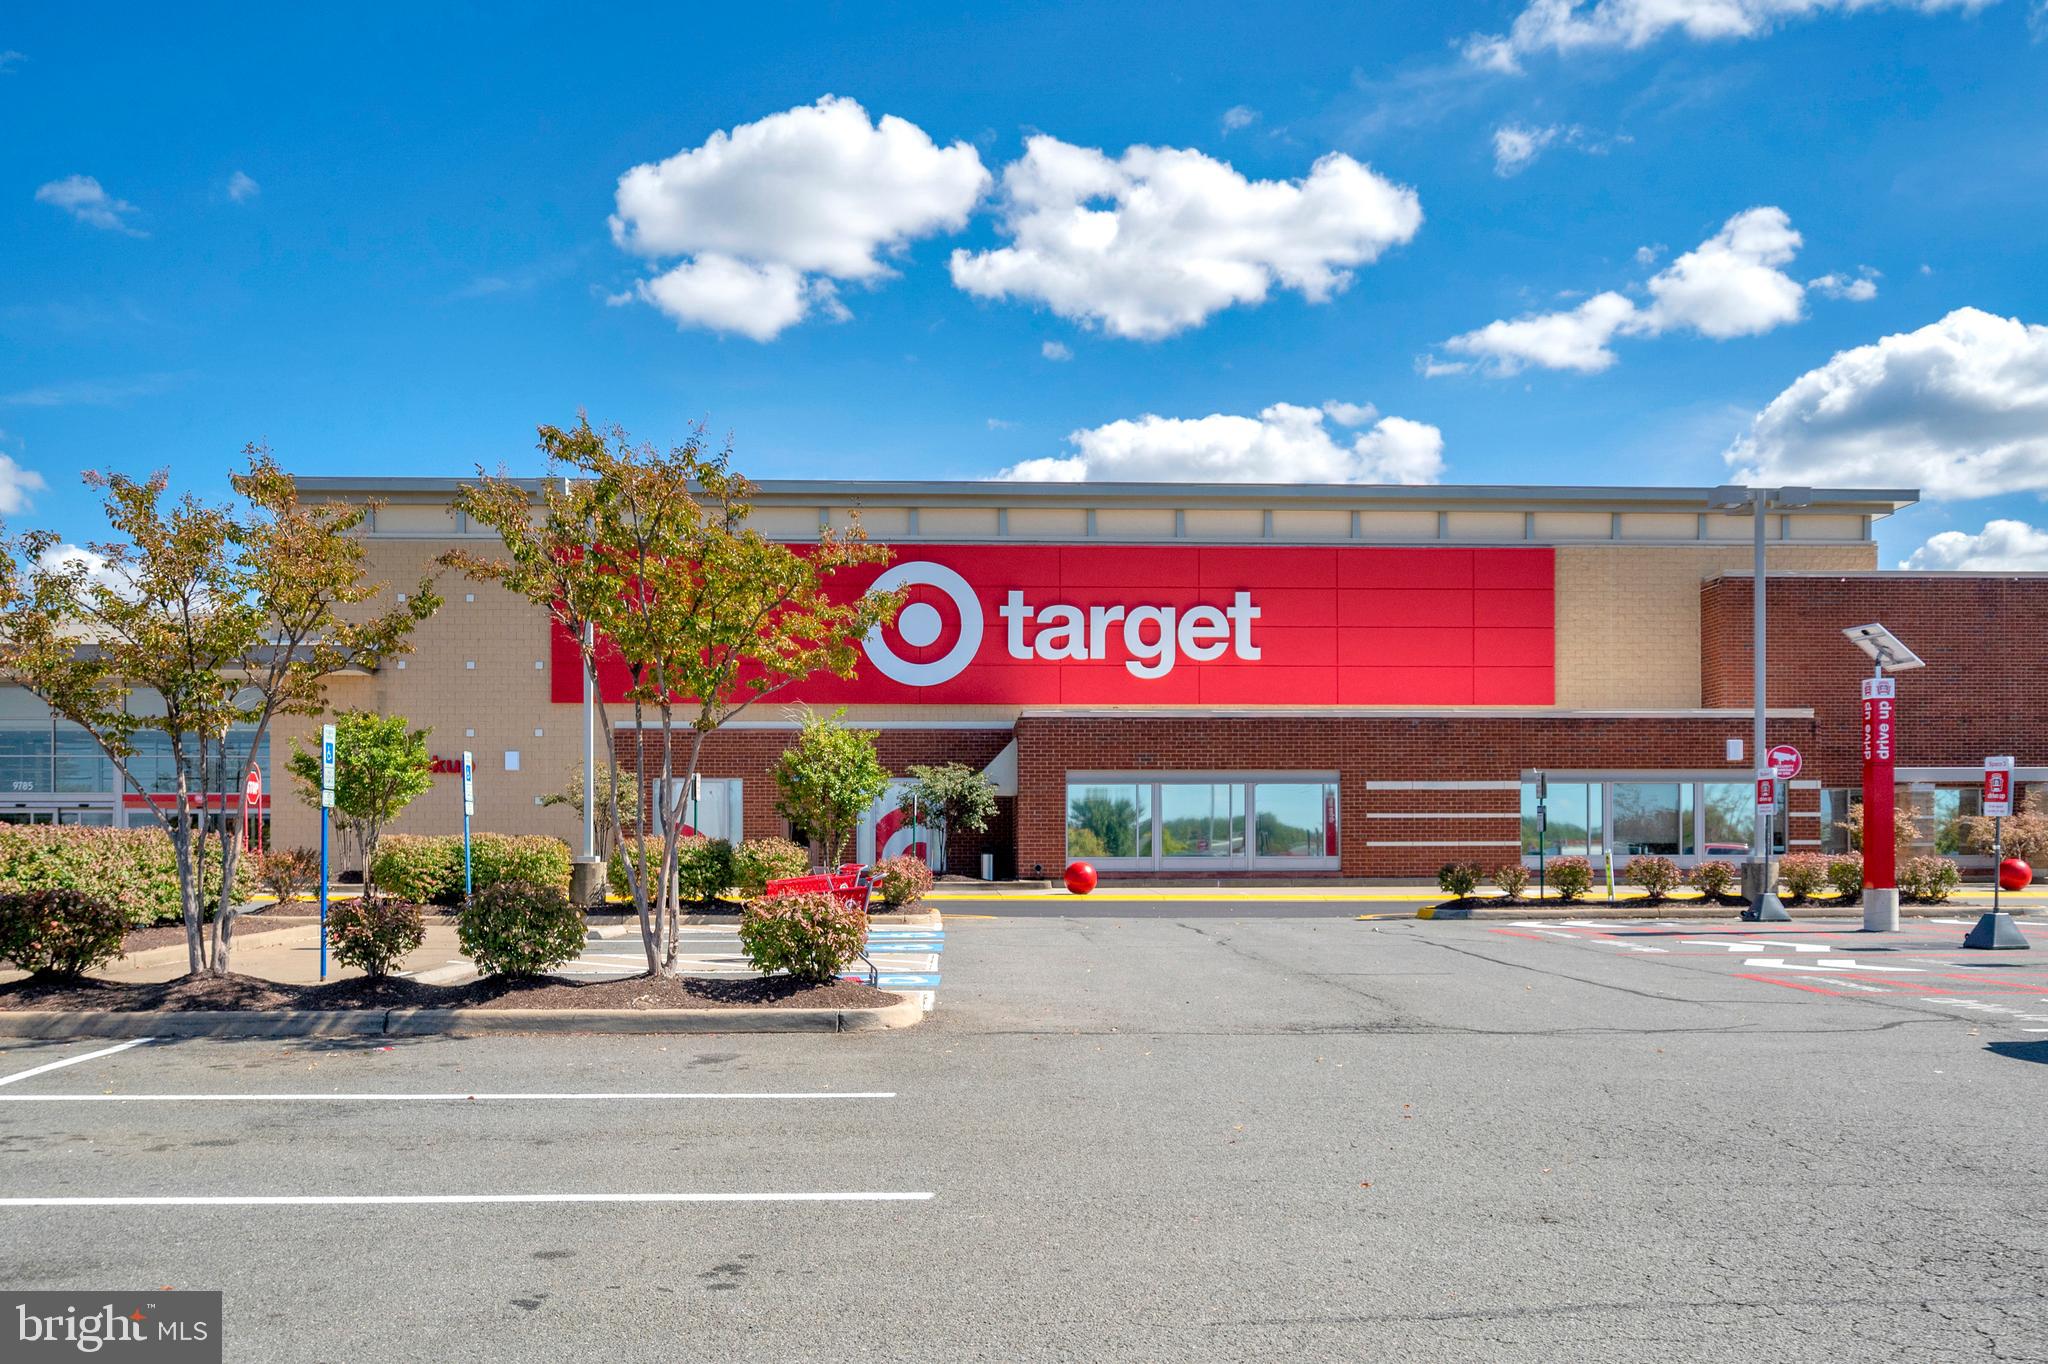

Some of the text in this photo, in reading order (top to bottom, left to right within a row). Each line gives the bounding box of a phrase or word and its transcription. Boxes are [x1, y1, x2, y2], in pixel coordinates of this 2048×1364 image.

[999, 590, 1261, 680] target
[1865, 702, 1872, 720] up
[1876, 701, 1892, 759] drive up
[12, 781, 34, 791] 9785
[246, 781, 259, 794] STOP
